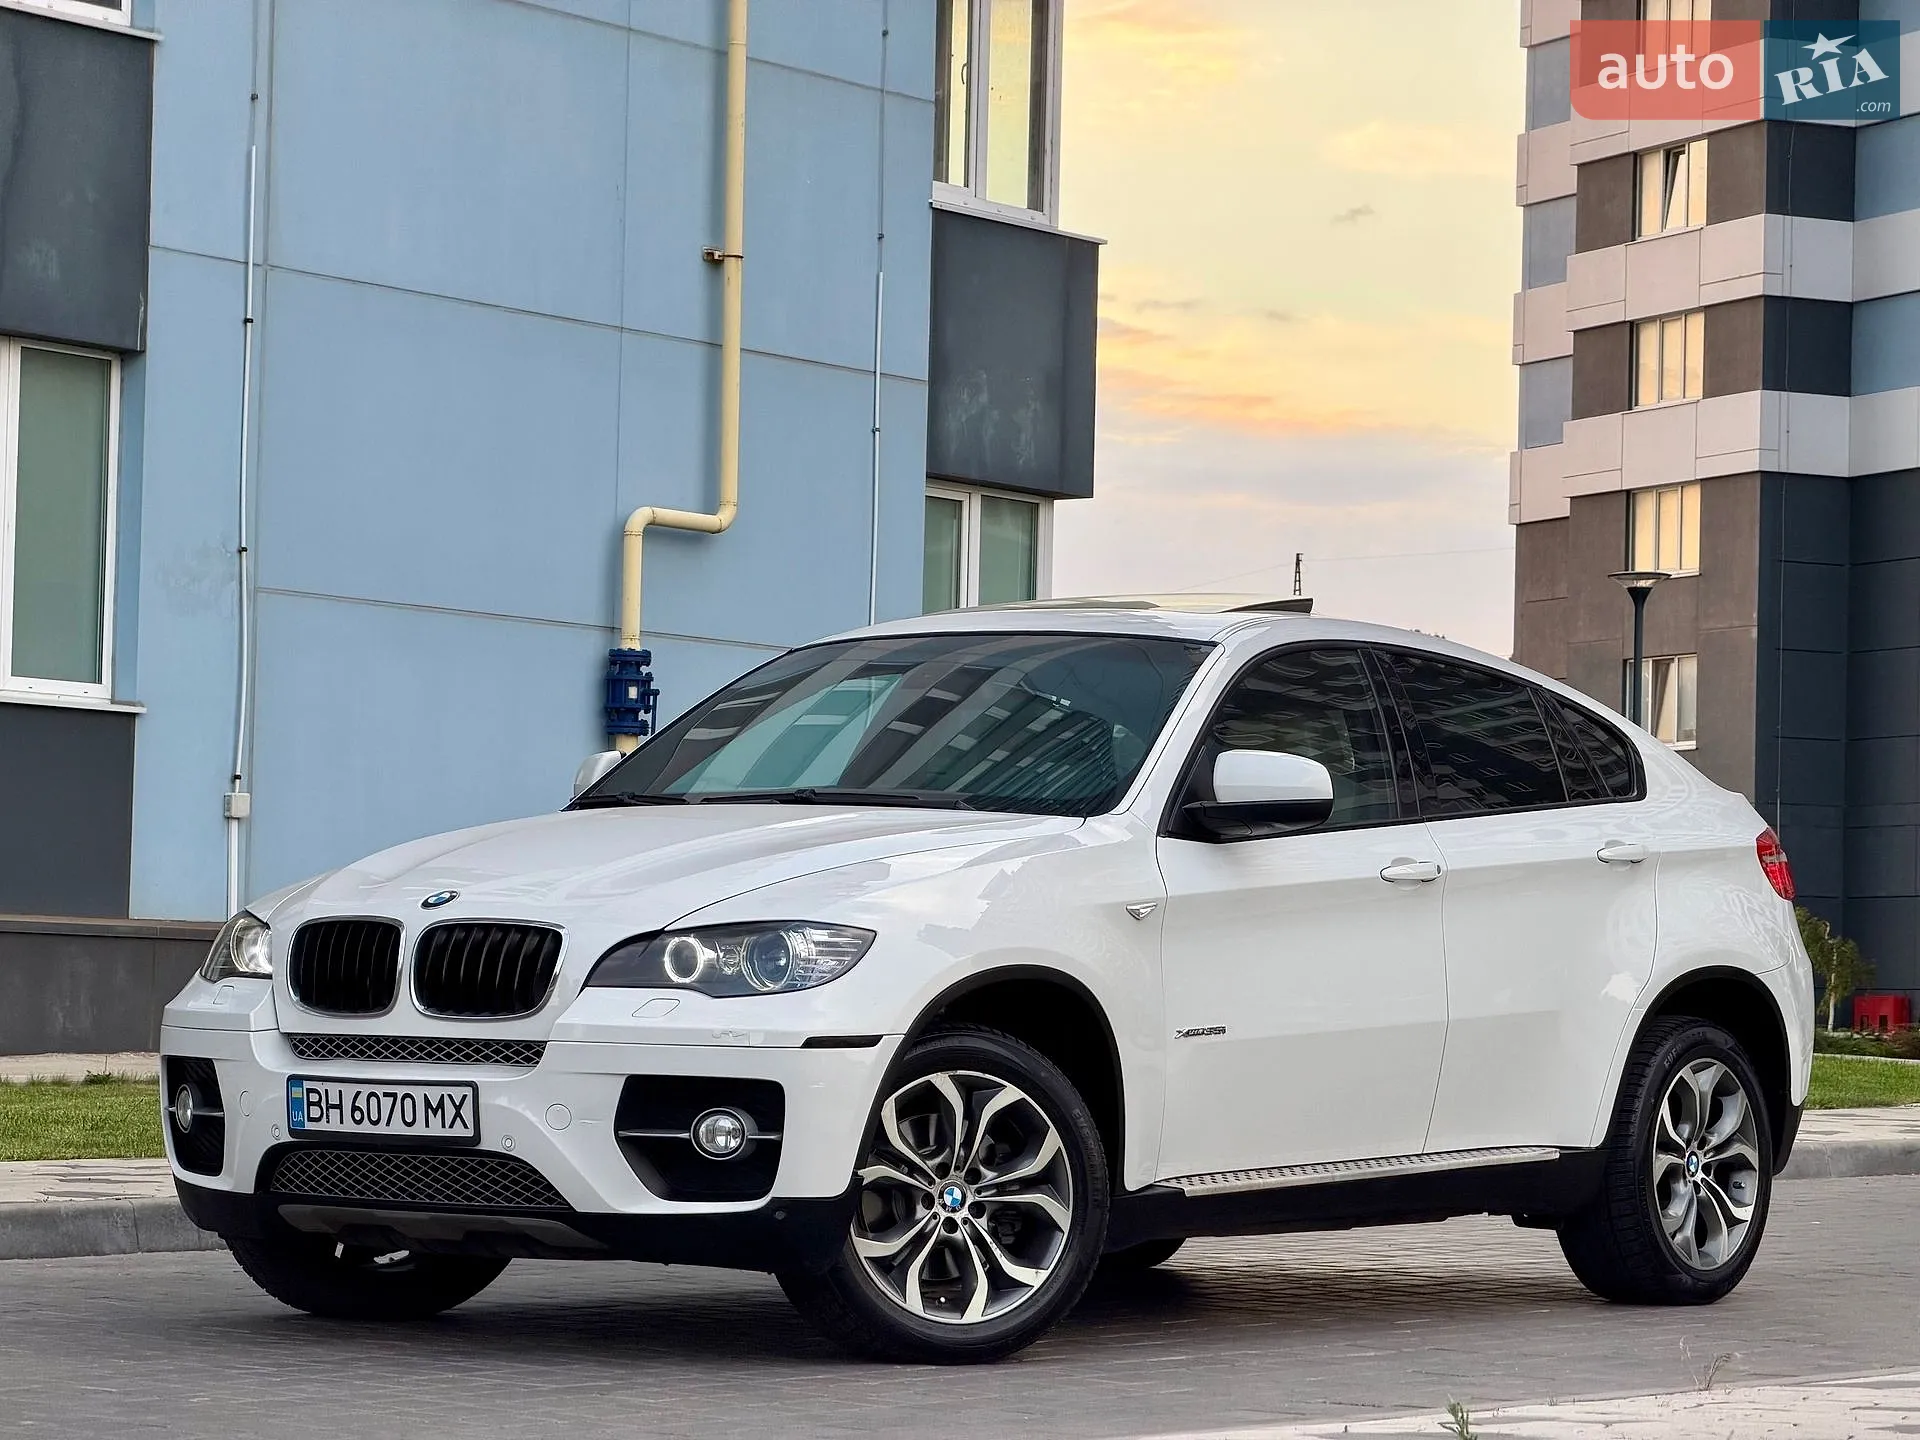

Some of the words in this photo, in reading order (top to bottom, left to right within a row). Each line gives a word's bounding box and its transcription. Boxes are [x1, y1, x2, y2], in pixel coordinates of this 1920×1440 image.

[292, 1110, 304, 1122] UA
[306, 1087, 344, 1125] BH
[350, 1090, 417, 1128] 6070
[424, 1093, 470, 1130] MX
